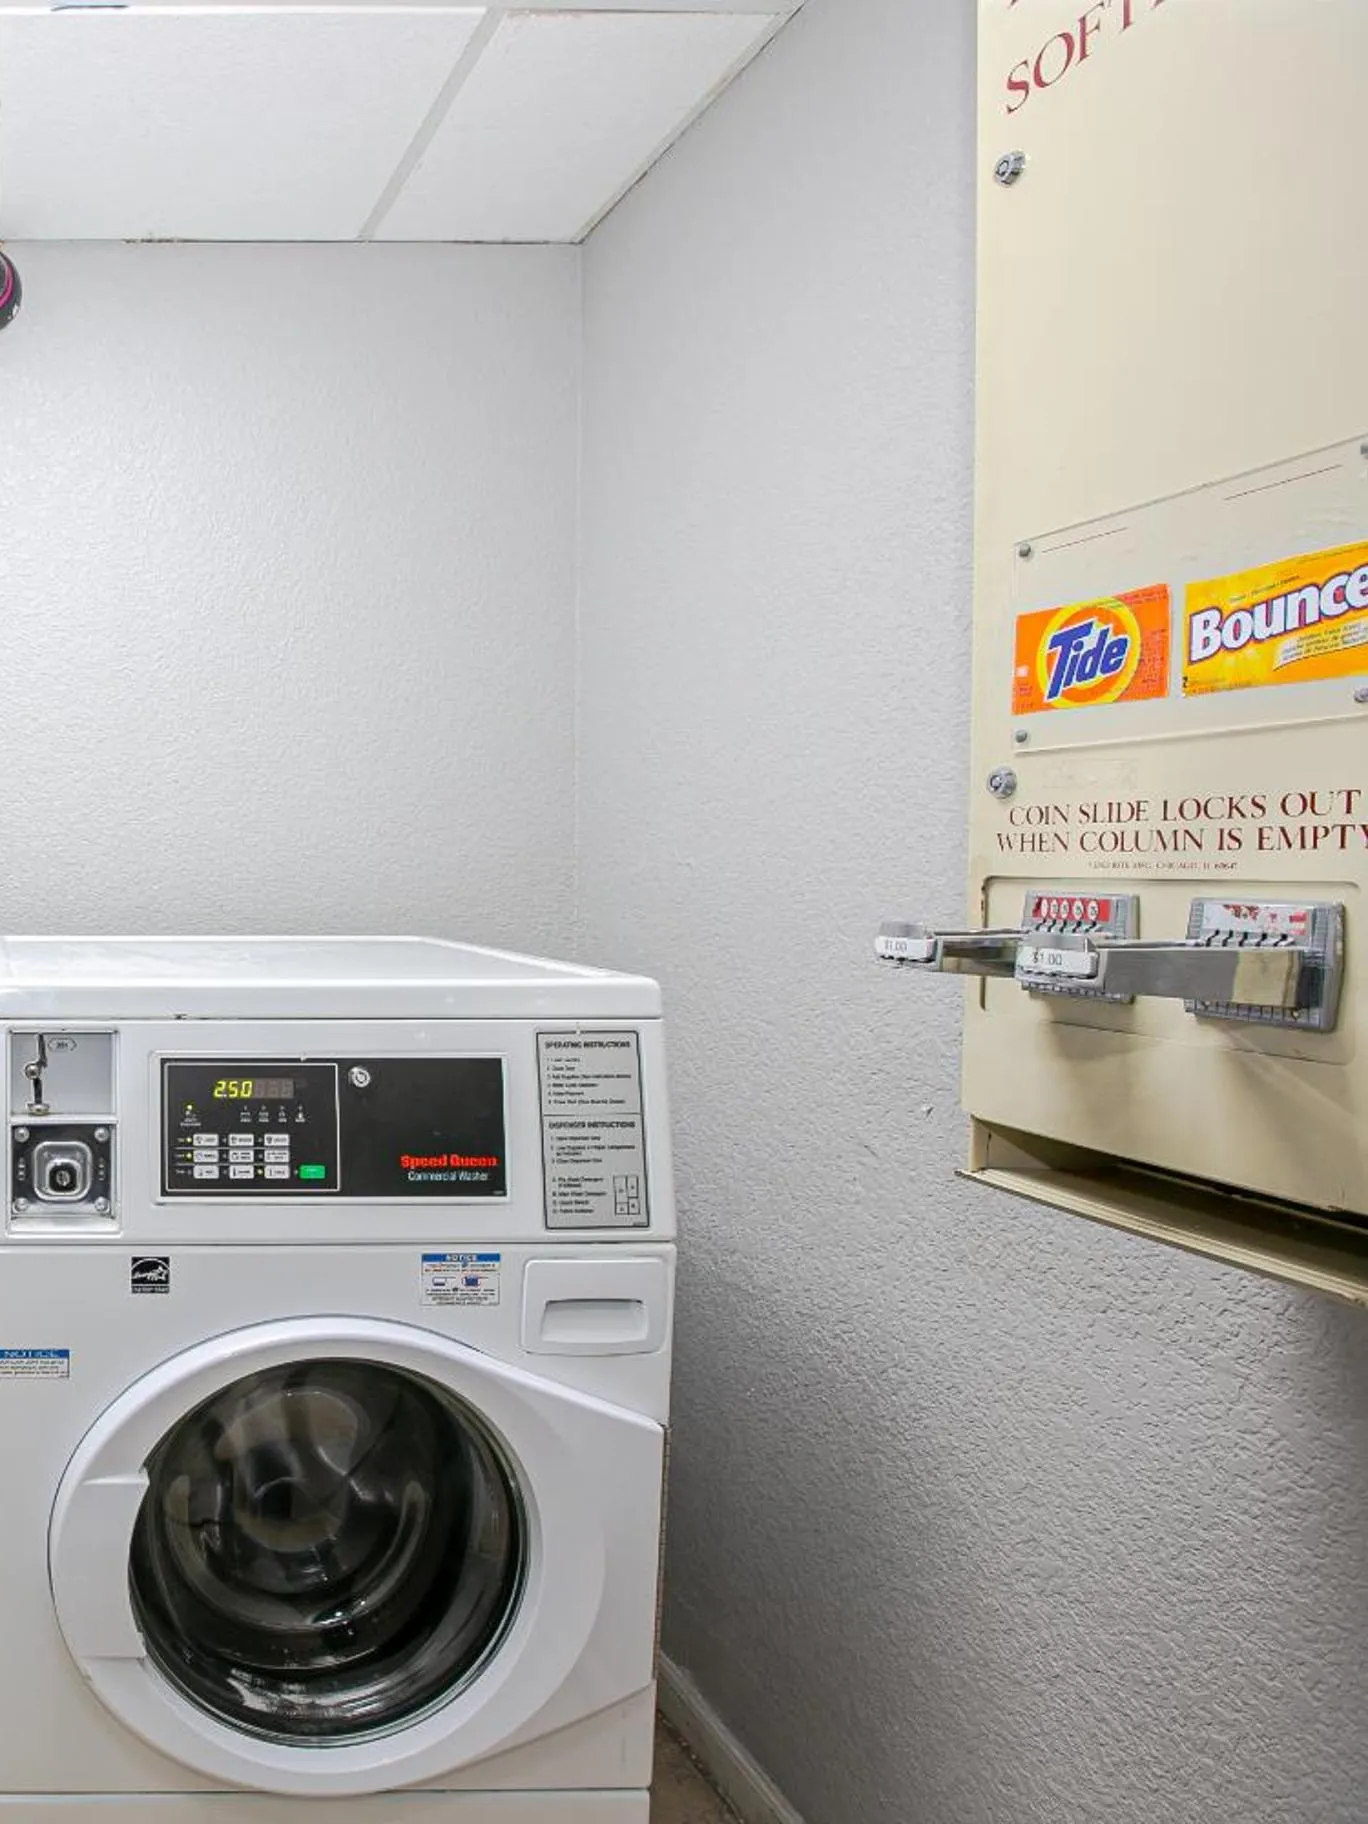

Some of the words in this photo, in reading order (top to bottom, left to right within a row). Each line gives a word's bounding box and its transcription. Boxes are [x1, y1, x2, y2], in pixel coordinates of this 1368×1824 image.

[1045, 619, 1129, 702] Tide
[1009, 804, 1070, 827] COIN
[1078, 799, 1149, 824] SLIDE
[1162, 794, 1267, 821] LOCKS
[1280, 789, 1362, 818] OUT
[996, 831, 1070, 852] WHEN
[1080, 828, 1205, 852] COLUMN
[1217, 826, 1244, 851] IS
[400, 1154, 448, 1169] Speed
[450, 1154, 497, 1167] Queen
[408, 1170, 457, 1181] Commercial
[458, 1170, 489, 1181] Washer
